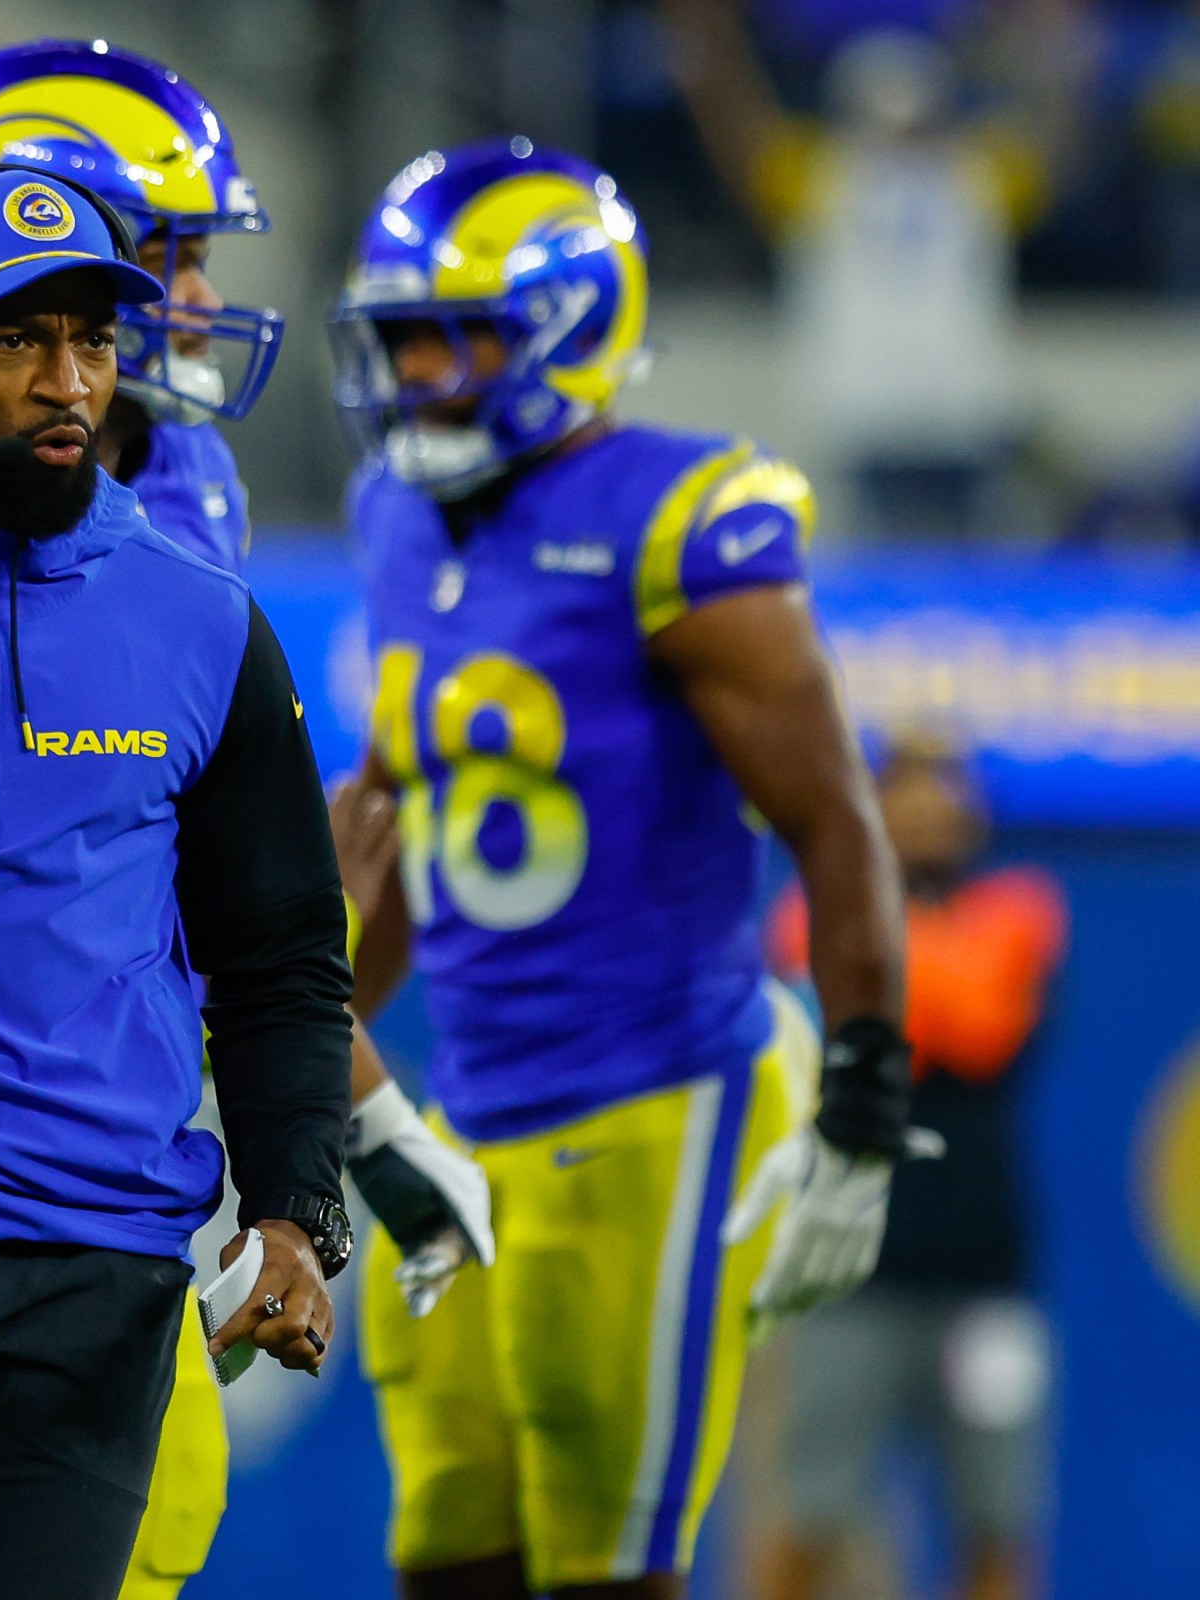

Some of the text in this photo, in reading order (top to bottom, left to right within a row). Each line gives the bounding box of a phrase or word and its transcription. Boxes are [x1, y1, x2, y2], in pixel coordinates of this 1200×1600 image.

[11, 195, 21, 206] LOS
[14, 219, 28, 230] LOS
[28, 227, 57, 235] ANGELES
[36, 729, 168, 758] RAMS
